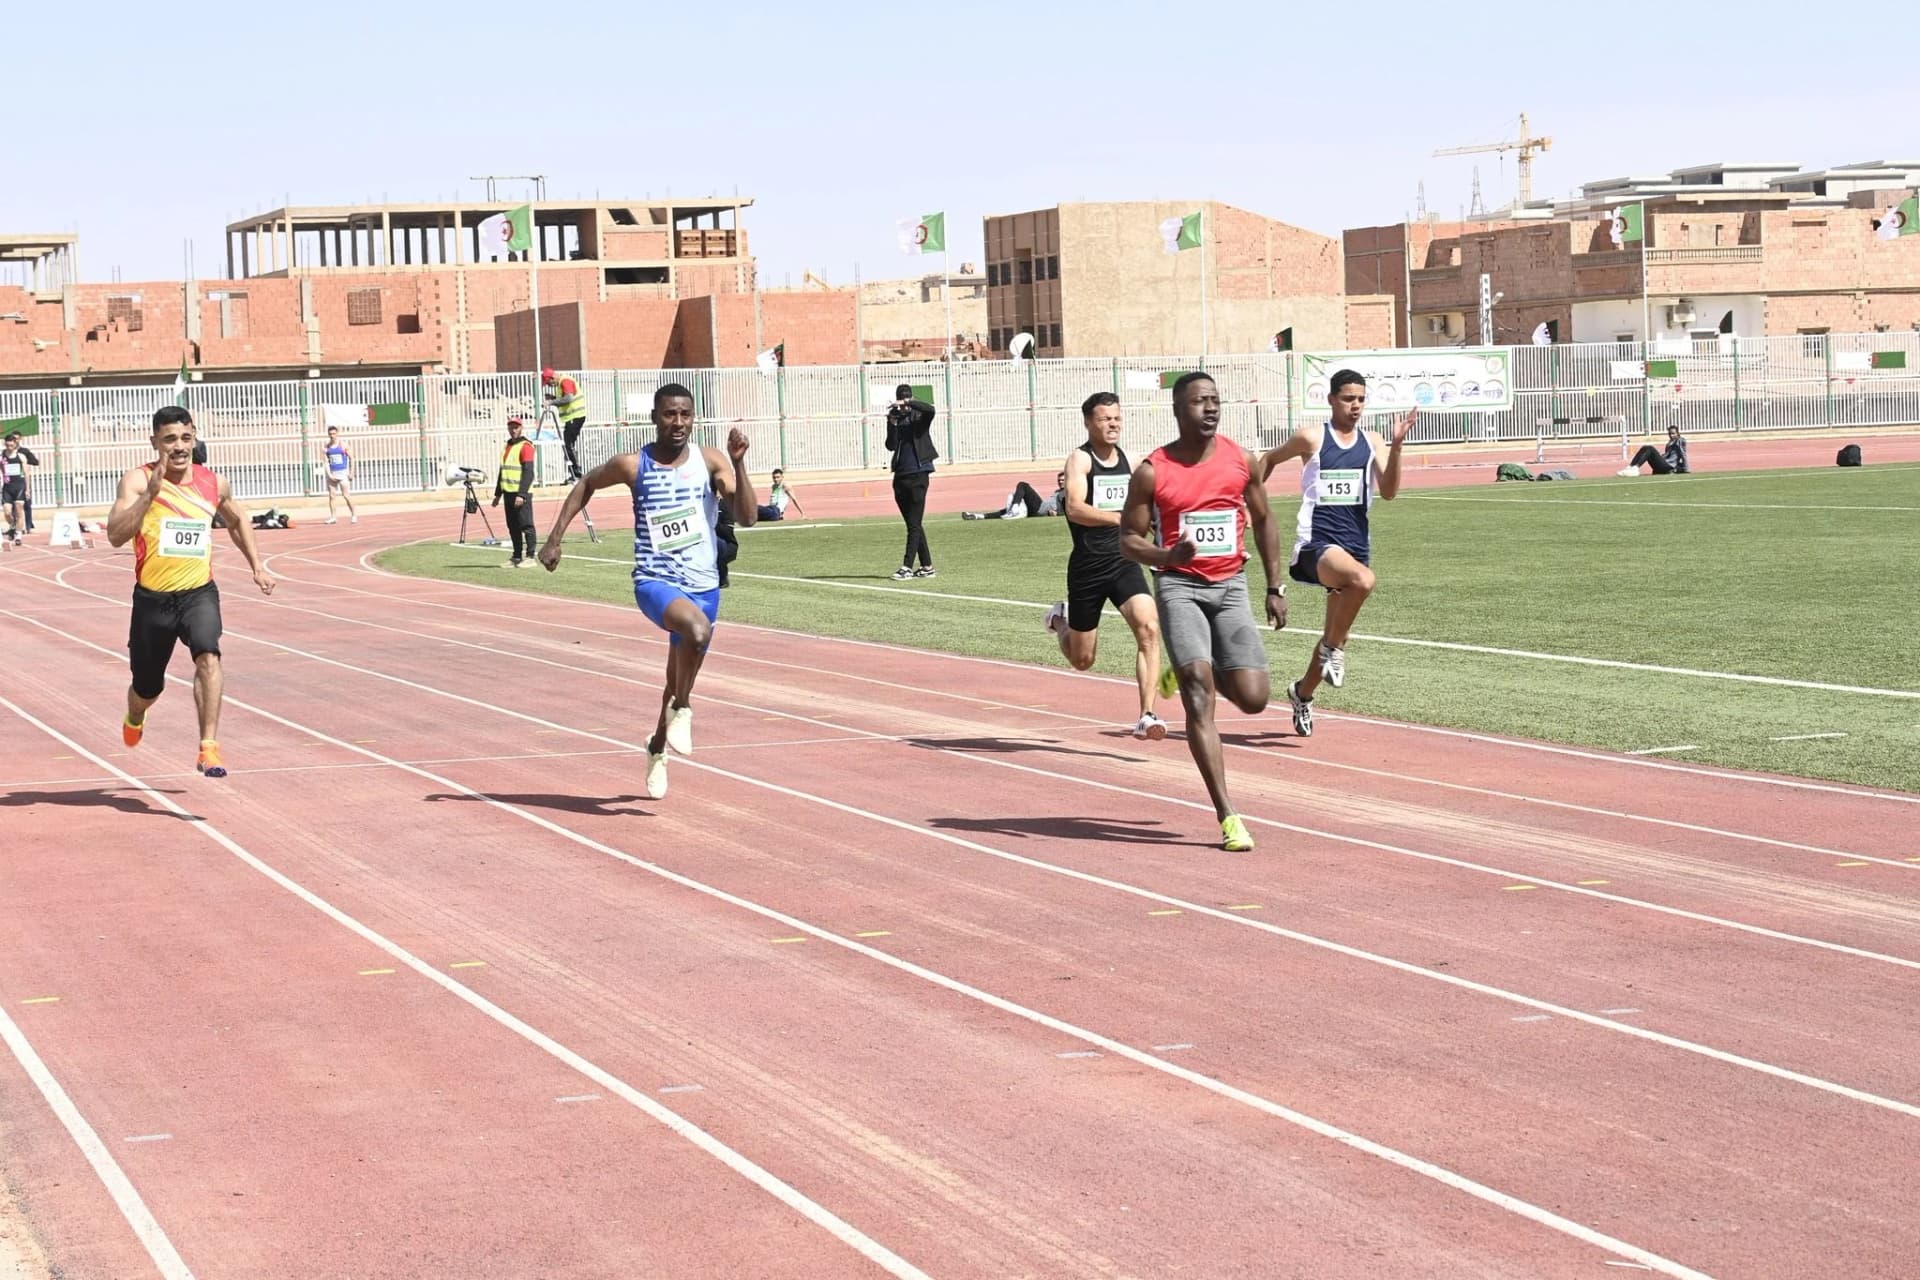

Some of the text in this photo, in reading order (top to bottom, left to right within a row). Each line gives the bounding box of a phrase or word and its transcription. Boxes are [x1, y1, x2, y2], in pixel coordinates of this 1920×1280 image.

[1106, 487, 1125, 500] 073
[1327, 482, 1351, 495] 153
[63, 524, 71, 537] 2
[662, 519, 689, 538] 091
[1195, 527, 1225, 543] 033
[175, 531, 200, 546] 097
